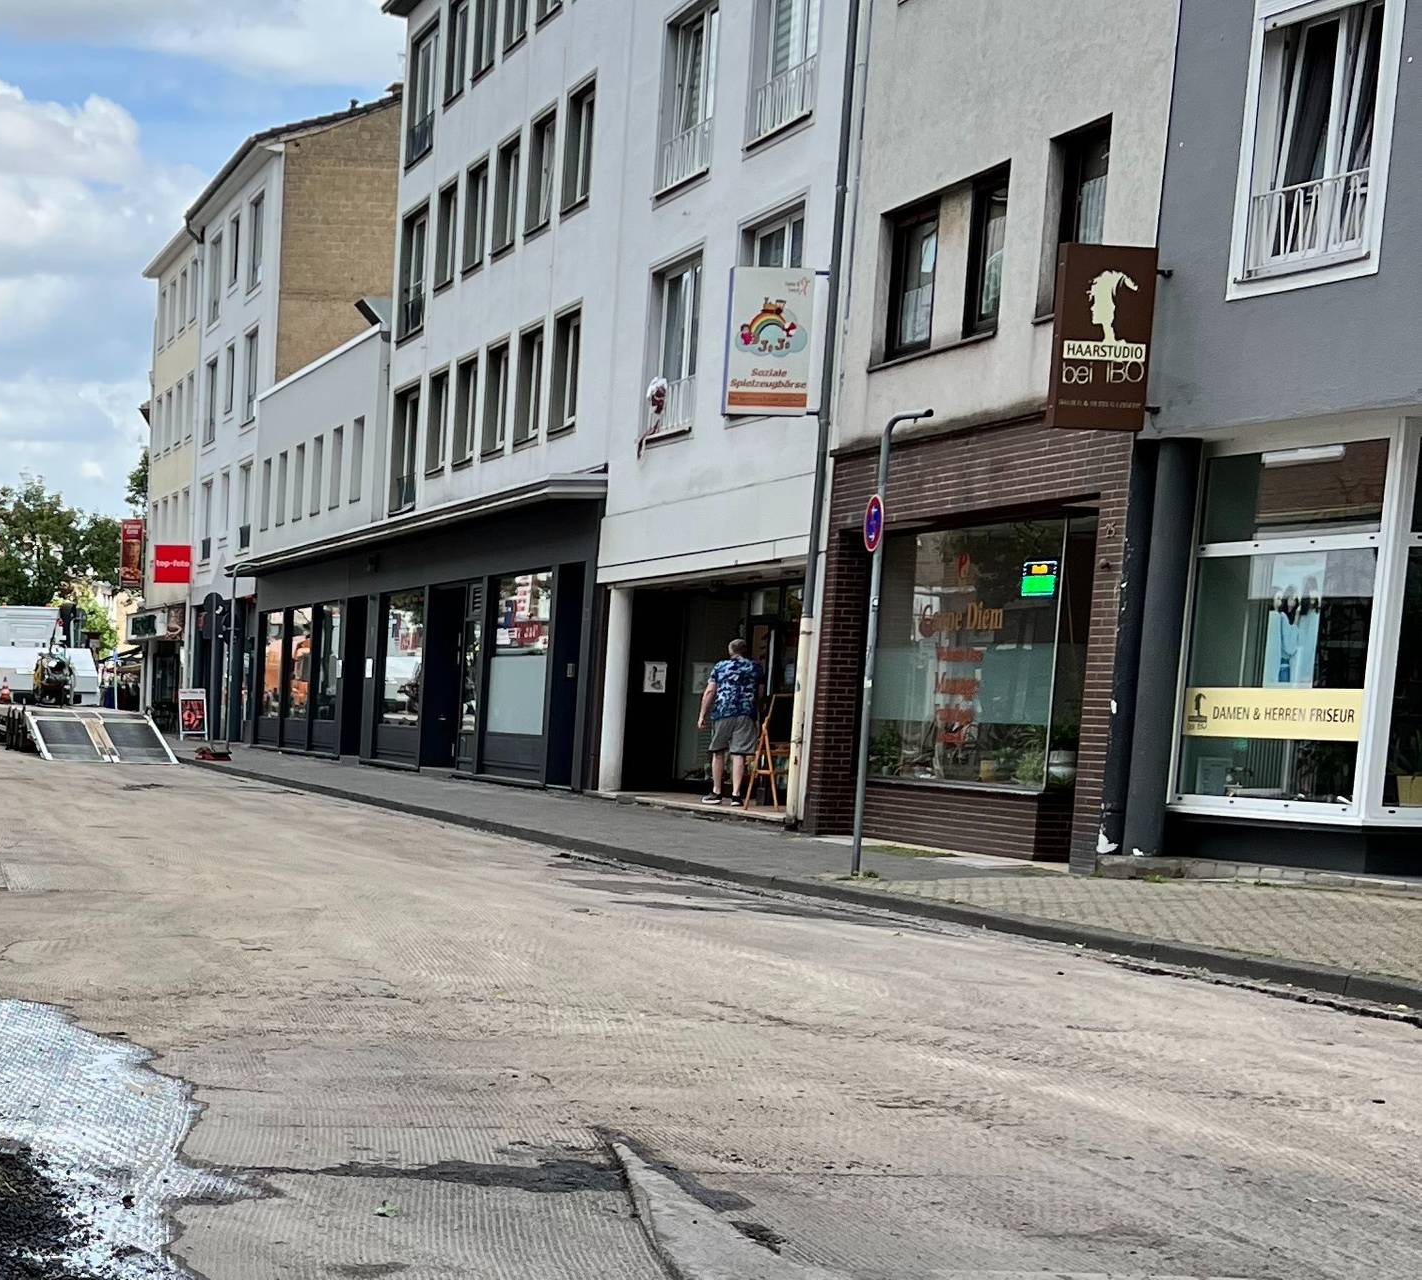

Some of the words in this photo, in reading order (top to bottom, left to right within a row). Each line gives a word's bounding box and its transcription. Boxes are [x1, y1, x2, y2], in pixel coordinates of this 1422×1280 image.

[1066, 343, 1143, 359] HAARSTUDIO
[751, 368, 787, 377] Soziale
[1062, 361, 1093, 384] bei
[1106, 360, 1145, 383] IBO
[730, 378, 807, 389] Spielzeugbörse
[156, 559, 190, 568] top-foto
[966, 602, 1003, 630] Diem
[1212, 706, 1250, 721] DAMEN
[1253, 709, 1261, 721] &
[1264, 708, 1305, 722] HERREN
[1309, 708, 1355, 723] FRISEUR
